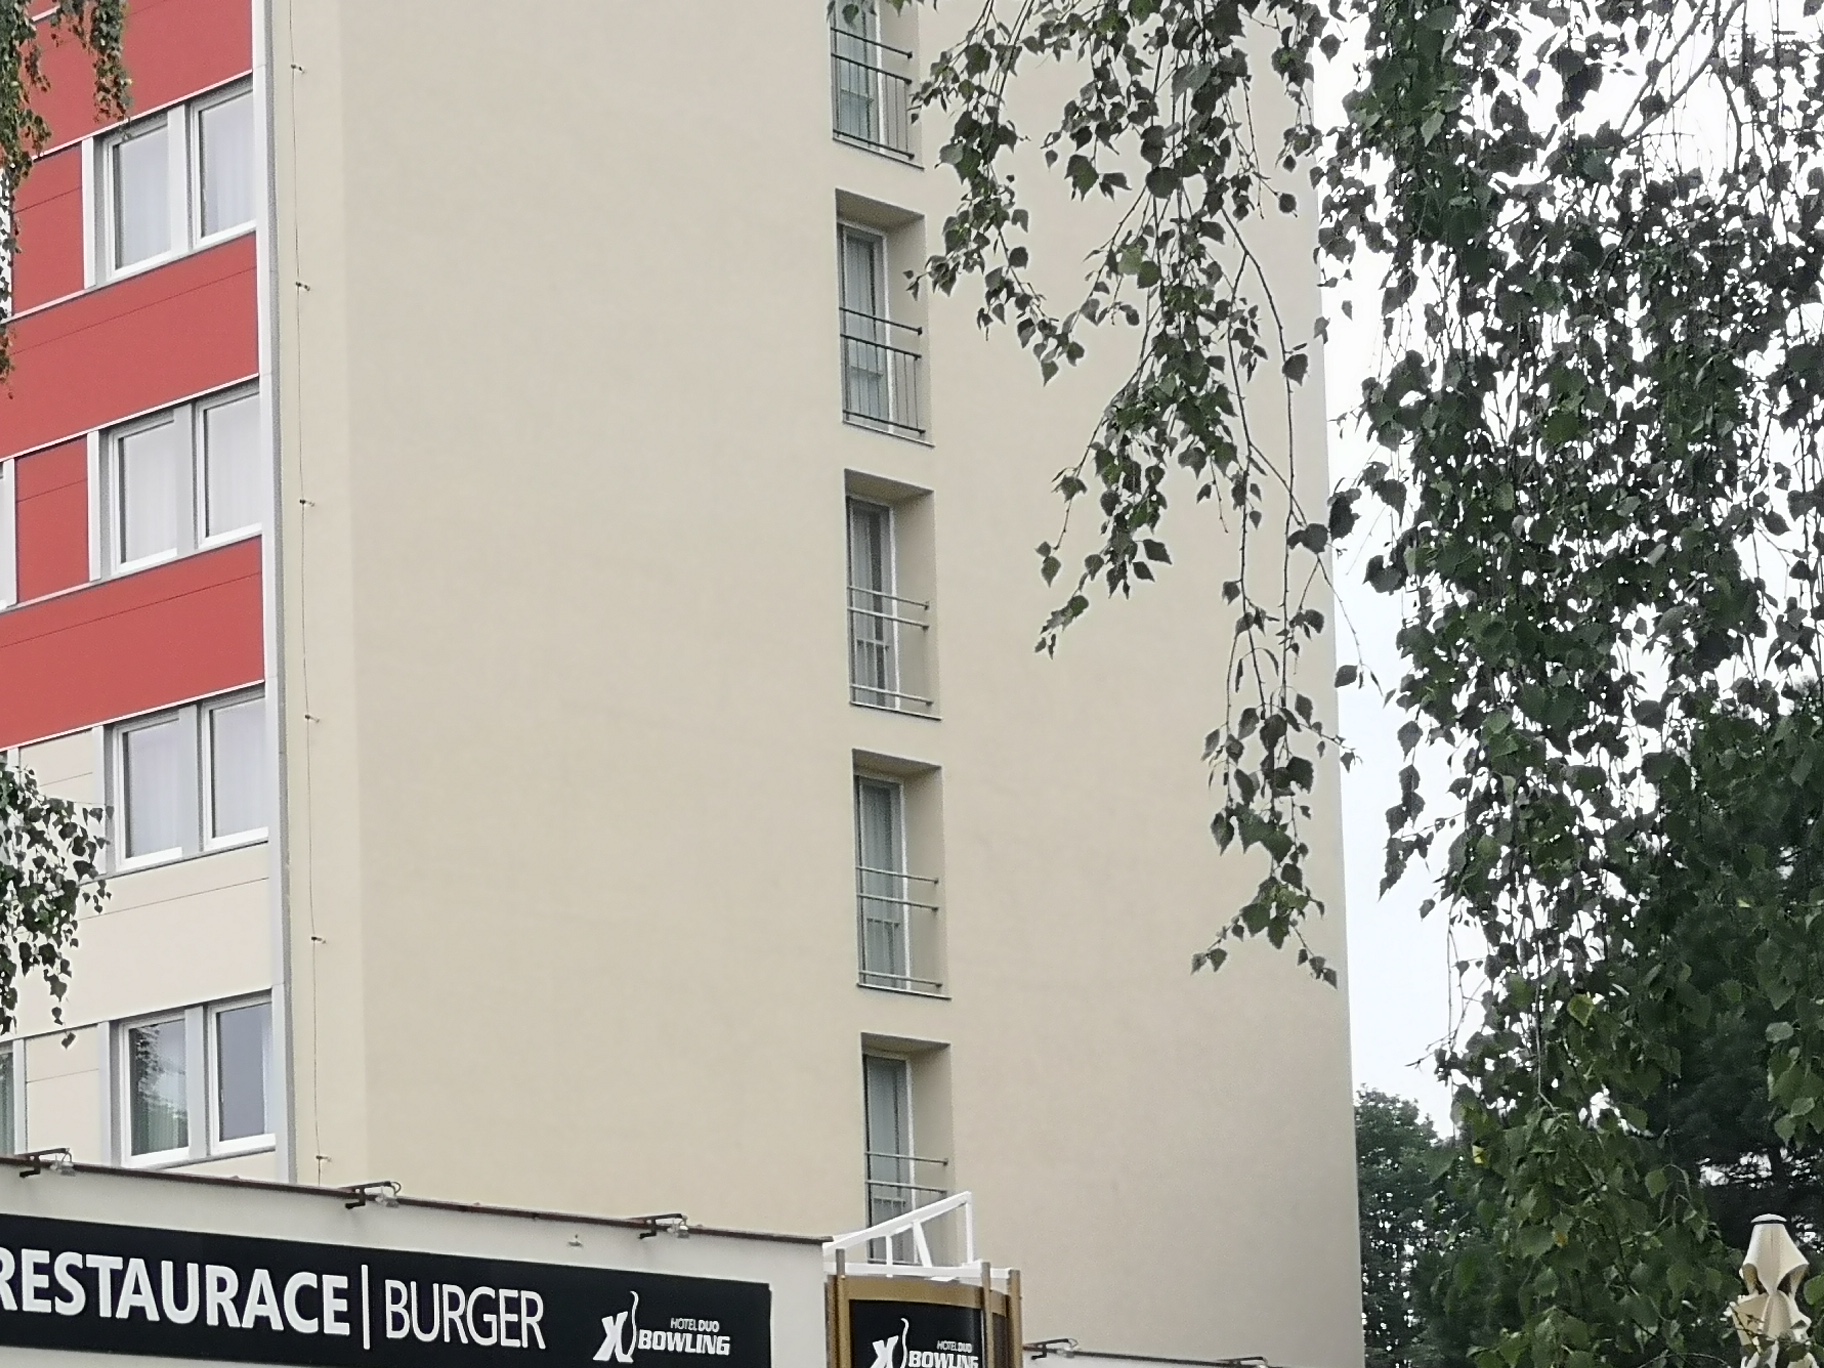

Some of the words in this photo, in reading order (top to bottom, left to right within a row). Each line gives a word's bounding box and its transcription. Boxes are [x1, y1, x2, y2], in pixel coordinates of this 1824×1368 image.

[385, 1279, 547, 1351] BURGER
[670, 1317, 697, 1331] HOTEL
[698, 1319, 720, 1332] DUO
[638, 1329, 731, 1356] BOWLING
